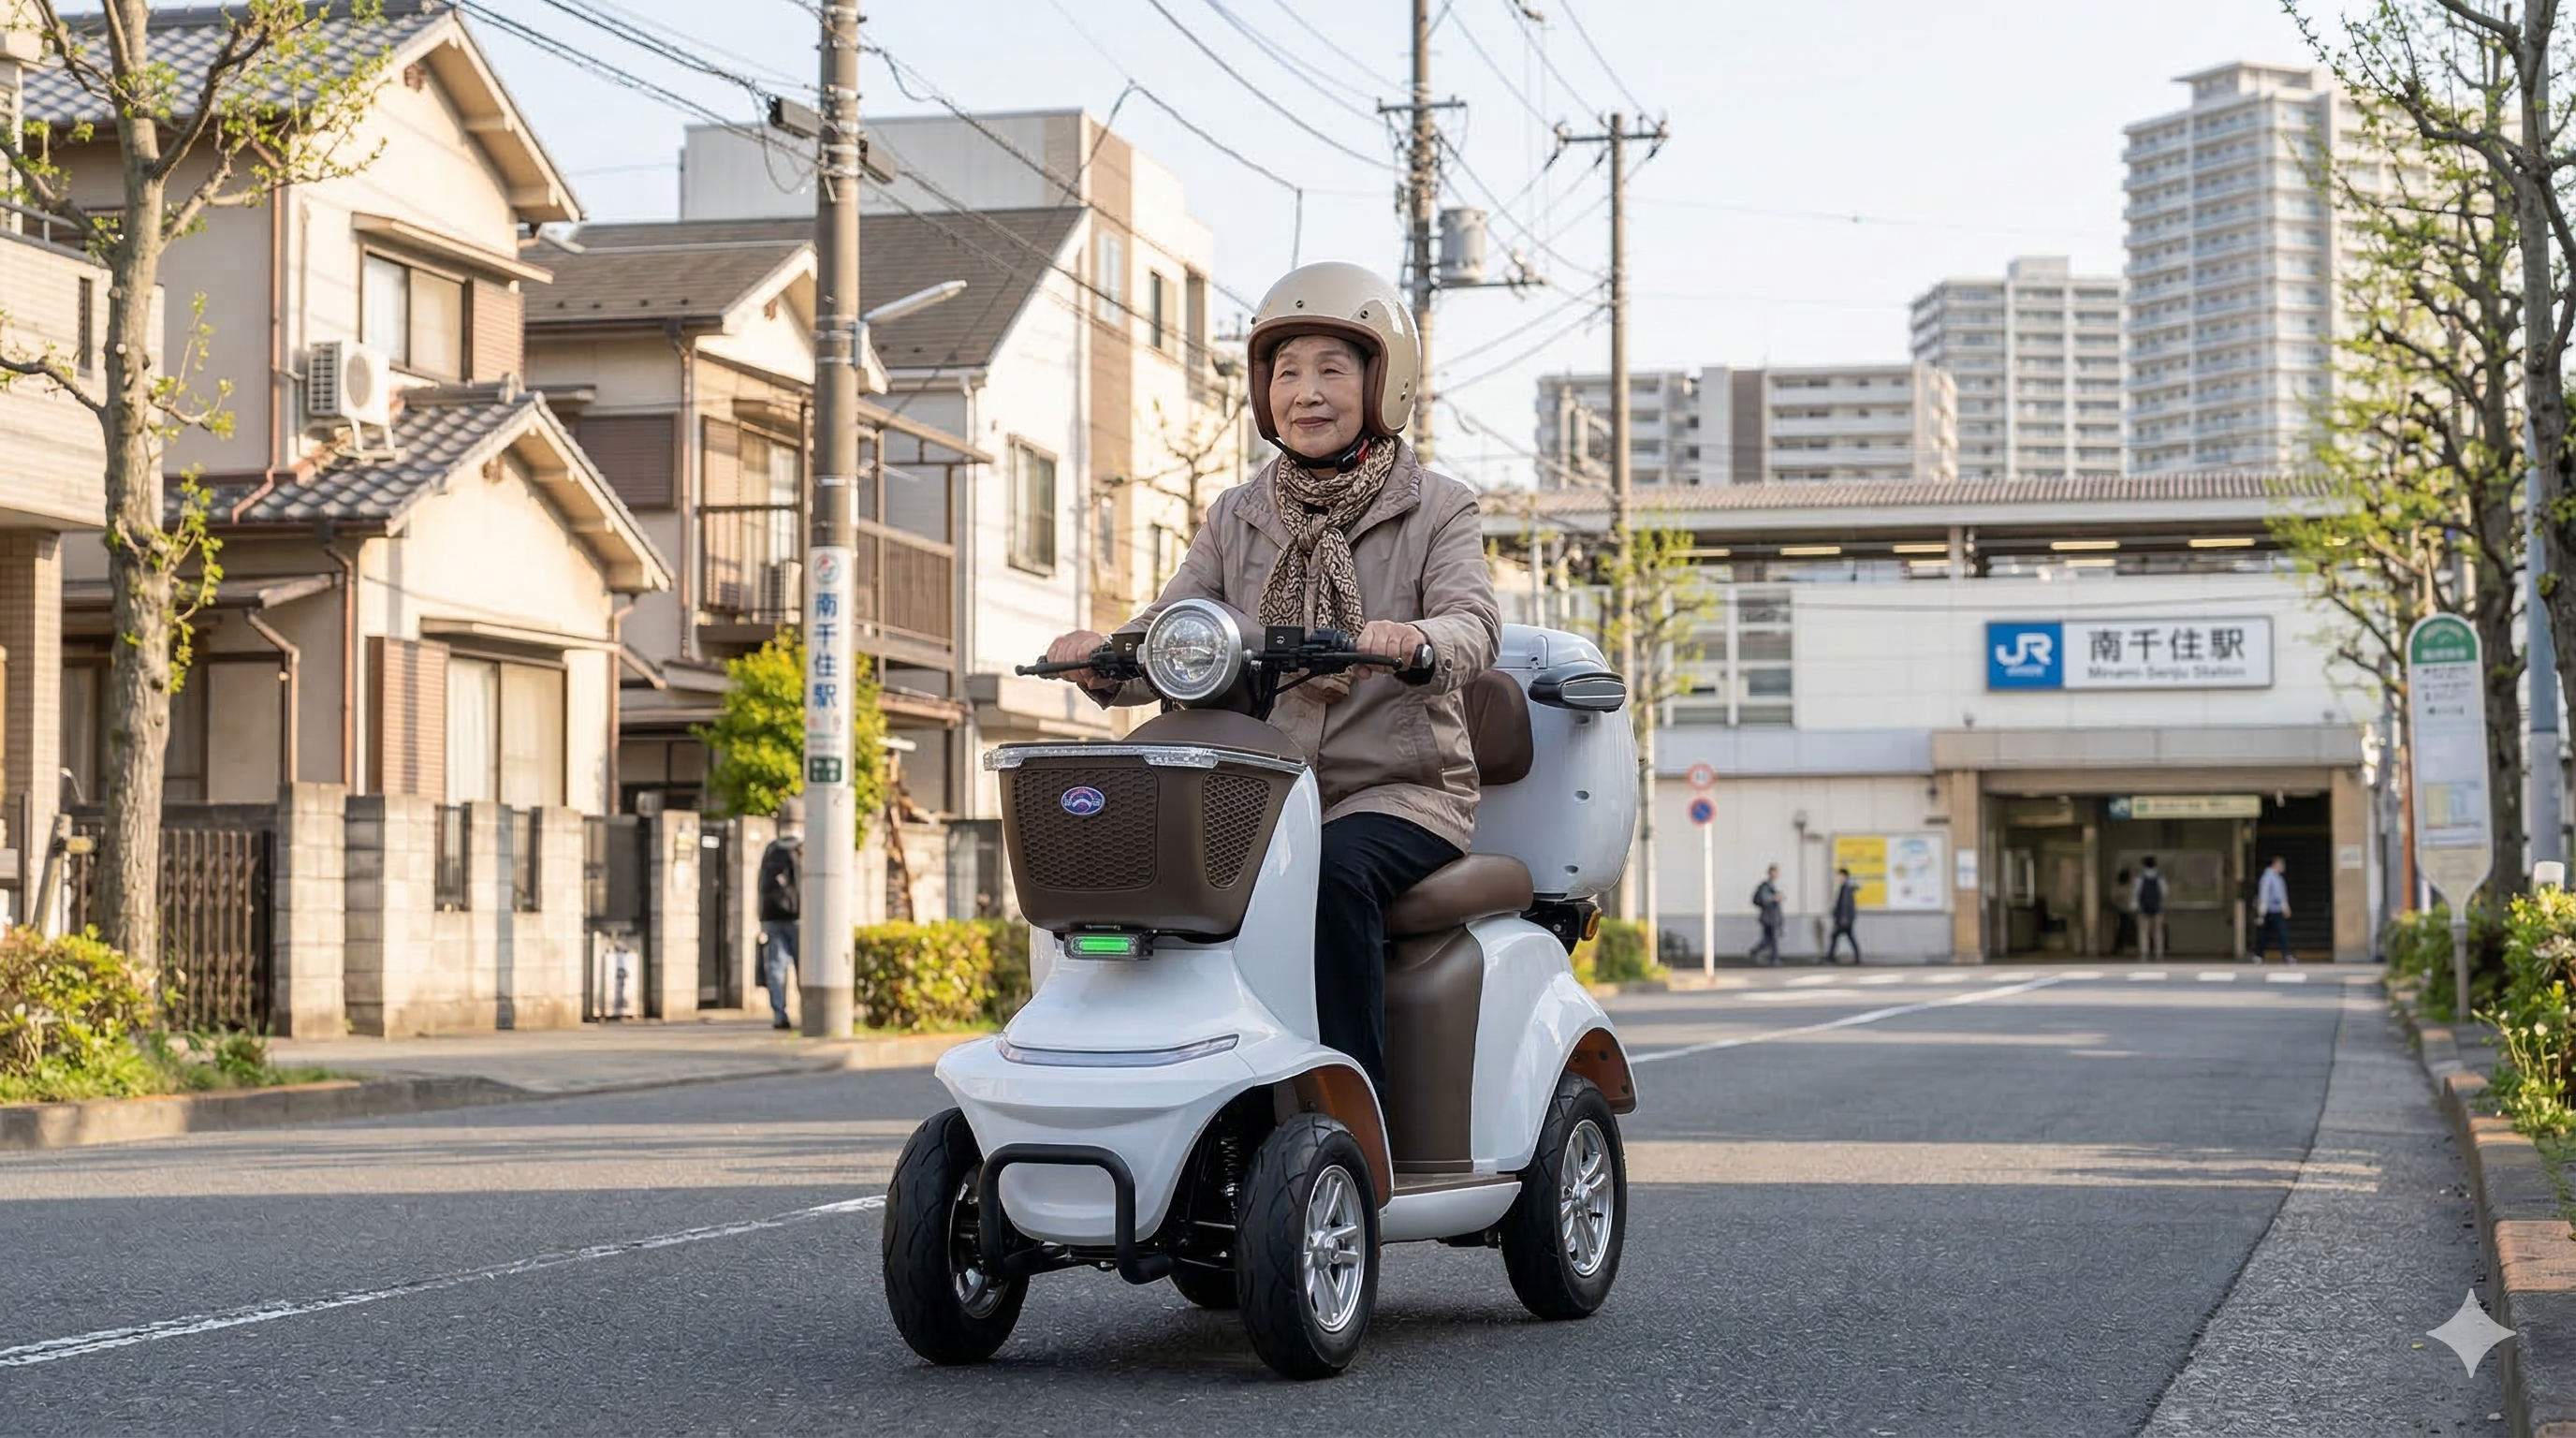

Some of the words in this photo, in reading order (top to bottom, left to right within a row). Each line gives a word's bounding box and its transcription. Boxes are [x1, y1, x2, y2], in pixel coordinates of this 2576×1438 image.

[812, 592, 838, 709] 南千住駅
[1995, 632, 2054, 667] JR
[2087, 627, 2246, 662] 南千住駅
[2193, 665, 2247, 679] Station
